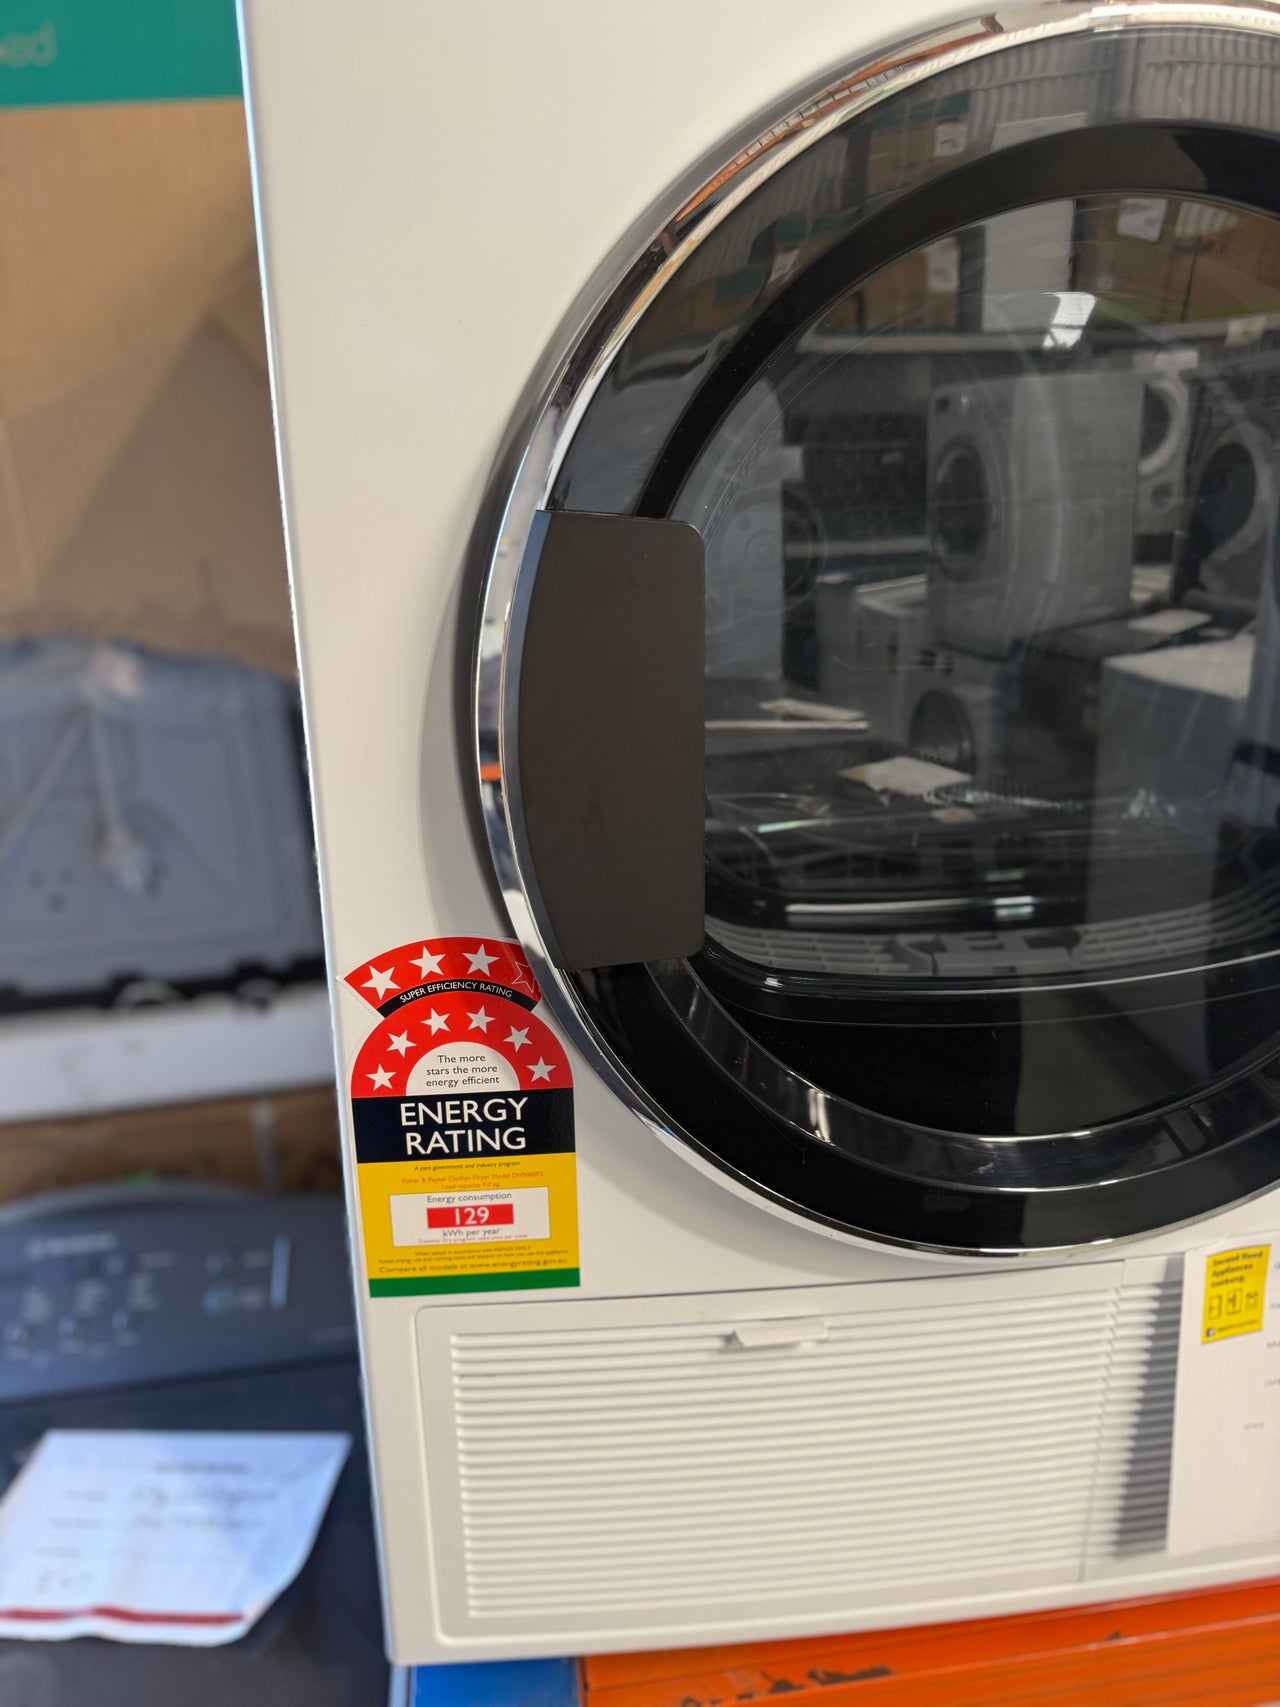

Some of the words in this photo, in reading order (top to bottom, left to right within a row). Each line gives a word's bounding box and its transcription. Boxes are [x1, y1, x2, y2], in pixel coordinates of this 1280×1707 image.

[400, 988, 427, 1003] SUPER
[427, 981, 478, 993] EFFICIENCY
[480, 983, 513, 998] RATING
[437, 1055, 456, 1063] The
[460, 1055, 486, 1063] more
[453, 1066, 469, 1074] the
[426, 1079, 459, 1088] energy
[462, 1076, 500, 1085] efficient
[400, 1097, 528, 1126] ENERGY
[406, 1127, 526, 1155] RATING
[427, 1195, 456, 1204] Energy
[458, 1192, 512, 1202] consumption
[455, 1206, 490, 1226] 129
[442, 1229, 464, 1237] kWh
[379, 1265, 417, 1274] Compare
[418, 1264, 427, 1272] all
[429, 1263, 458, 1271] models
